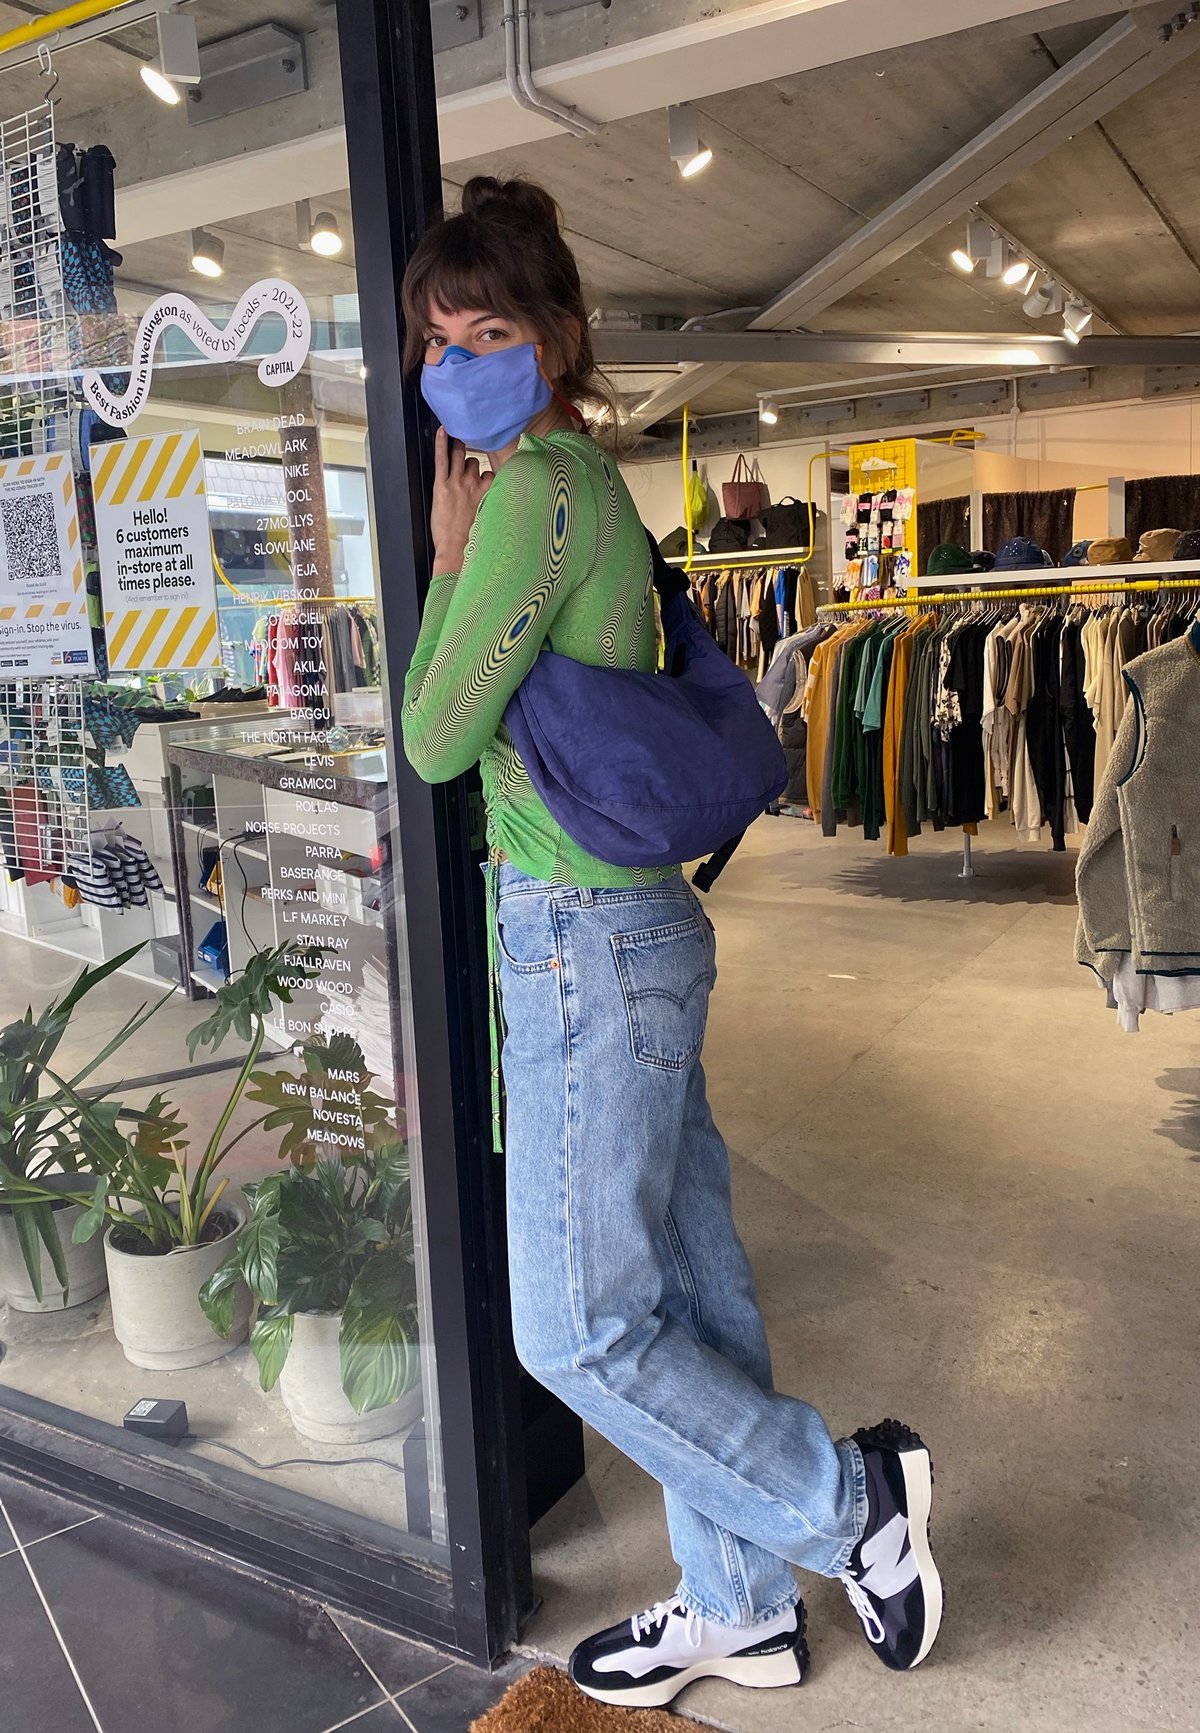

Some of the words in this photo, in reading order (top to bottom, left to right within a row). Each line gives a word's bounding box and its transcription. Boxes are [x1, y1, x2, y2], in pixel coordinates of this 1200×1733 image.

[90, 381, 110, 412] Best
[110, 388, 144, 420] Fashion
[137, 370, 147, 384] in
[180, 309, 192, 323] as
[192, 321, 220, 351] voted
[222, 336, 236, 351] by
[234, 298, 260, 338] locals
[271, 287, 303, 338] 2021-22
[265, 361, 295, 376] CAPITAL
[272, 413, 305, 431] DEAD
[225, 438, 308, 461] MEADOWLARK
[284, 463, 310, 479] NIKE
[133, 508, 168, 526] Hello!
[256, 514, 314, 531] 27MOLLYS
[116, 529, 124, 543] 6
[126, 526, 189, 543] customers
[125, 541, 183, 559] maximum
[253, 538, 316, 555] SLOWLANE
[117, 560, 162, 575] in-store
[165, 557, 177, 571] at
[179, 554, 193, 570] all
[288, 563, 318, 577] VEJA
[118, 576, 150, 591] times
[153, 572, 195, 593] please.
[232, 590, 268, 605] HENRIK
[272, 587, 320, 602] VIBSKOV
[26, 623, 45, 634] Stop
[46, 622, 60, 632] the
[60, 620, 82, 630] virus.
[263, 612, 324, 627] COE&CIEL
[244, 638, 299, 650] MEDICOM
[301, 637, 323, 649] TOY
[293, 660, 327, 673] AKILA
[290, 708, 330, 720] BAGGU
[240, 731, 261, 743] THE
[263, 732, 300, 743] NORTH
[303, 732, 333, 744] FACE
[304, 755, 335, 766] LEVIS
[279, 777, 336, 790] GRAMICCI
[296, 800, 339, 813] ROLLAS
[245, 821, 281, 834] NORSE
[283, 823, 341, 836] PROJECTS
[305, 846, 342, 859] PARRA
[280, 867, 344, 881] BASERANGE
[261, 887, 293, 901] PERKS
[296, 890, 319, 902] AND
[322, 892, 346, 904] MINI
[282, 911, 298, 923] L.F
[301, 912, 347, 927] MARKEY
[296, 934, 325, 947] STAN
[327, 937, 349, 949] RAY
[284, 955, 351, 972] FJALLRAVEN
[277, 975, 313, 990] WOOD
[315, 979, 353, 994] WOOD
[320, 1002, 355, 1016] CASIO
[273, 1018, 286, 1031] LE
[288, 1019, 311, 1033] BON
[314, 1022, 356, 1039] SHOPPE
[328, 1068, 360, 1083] MARS
[282, 1082, 307, 1097] NEW
[309, 1087, 361, 1106] BALANCE
[313, 1109, 363, 1127] NOVESTA
[307, 1129, 365, 1149] MEADOWS
